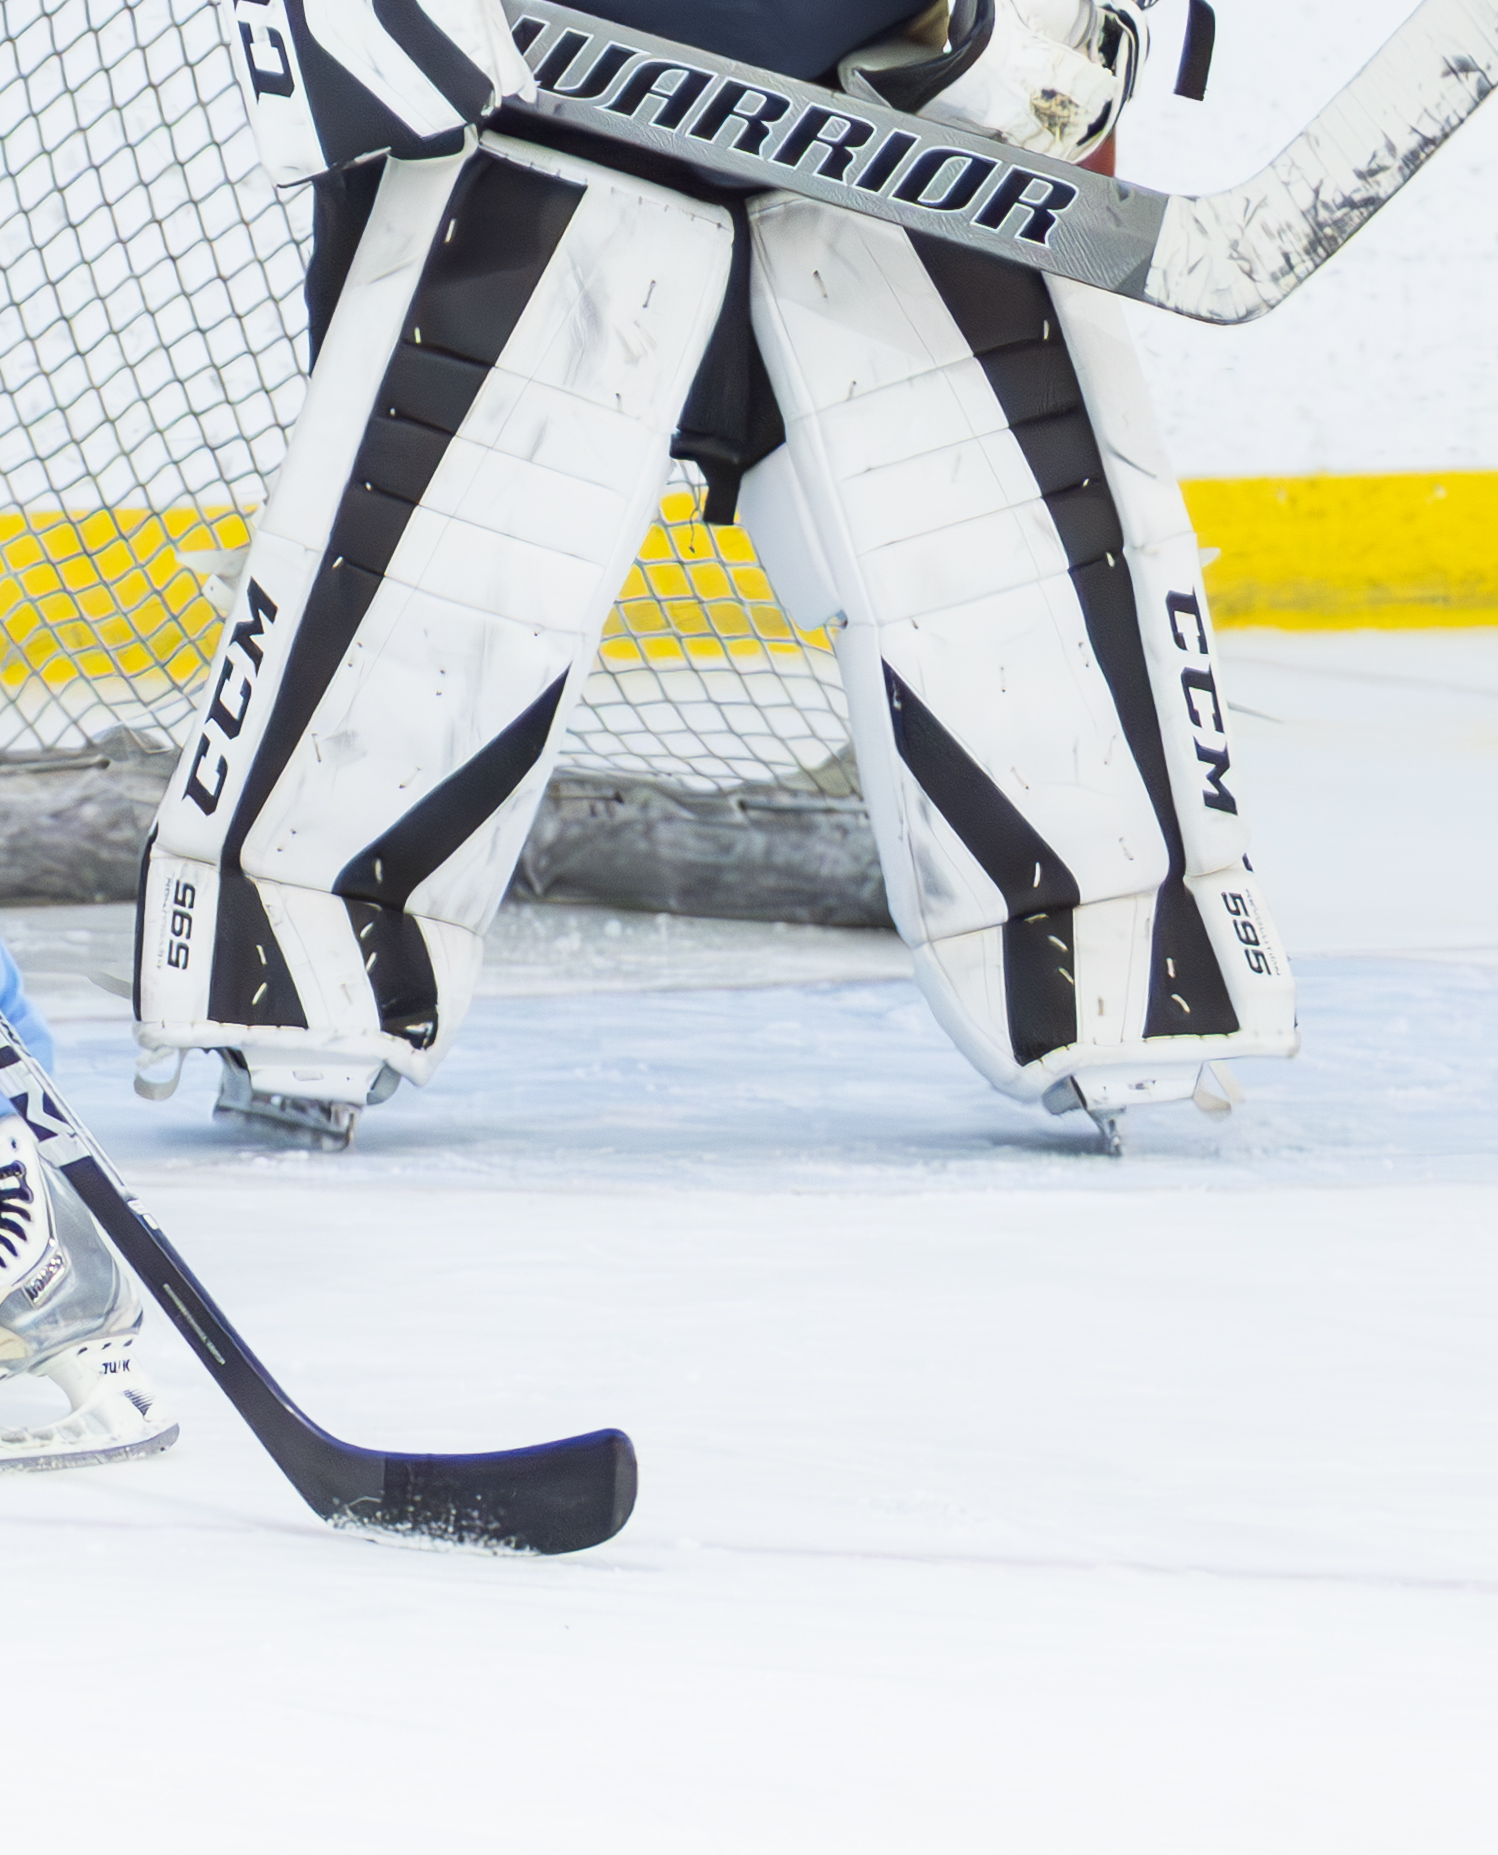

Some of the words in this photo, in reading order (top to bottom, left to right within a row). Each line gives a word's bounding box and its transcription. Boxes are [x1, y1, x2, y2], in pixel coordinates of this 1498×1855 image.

[510, 14, 1079, 248] WARRIOR
[182, 576, 279, 818] CCM
[1165, 586, 1239, 816] CCM
[167, 878, 196, 971] 595
[1221, 891, 1272, 976] 595
